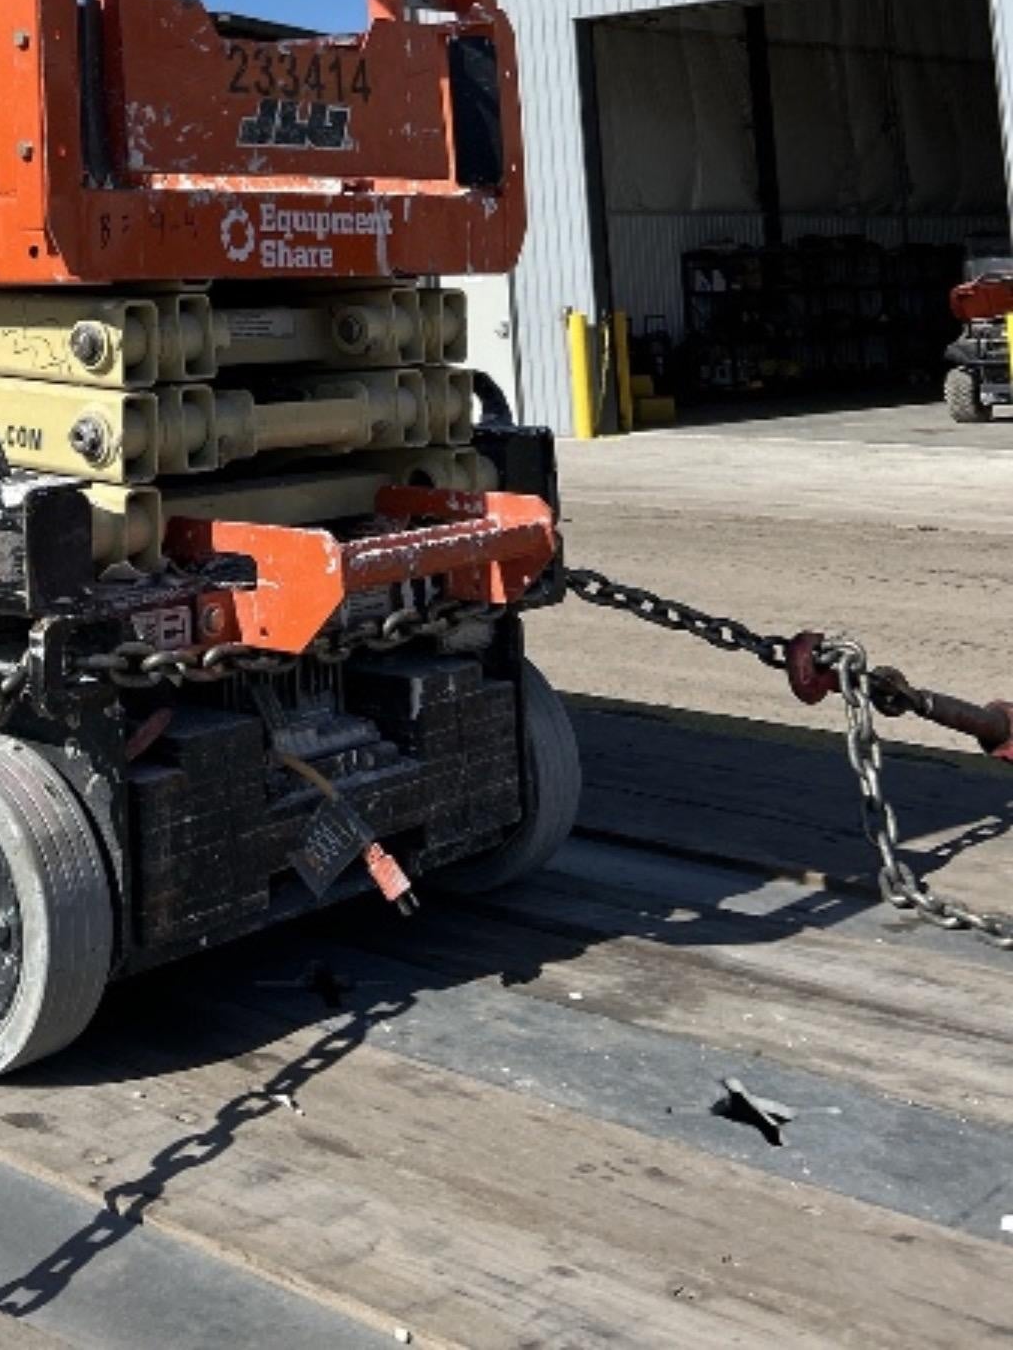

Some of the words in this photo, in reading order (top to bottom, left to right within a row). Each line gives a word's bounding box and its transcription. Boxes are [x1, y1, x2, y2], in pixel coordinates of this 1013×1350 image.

[224, 44, 372, 103] 233414
[237, 99, 354, 150] JLG
[259, 203, 393, 241] Equipment
[259, 239, 333, 268] Share
